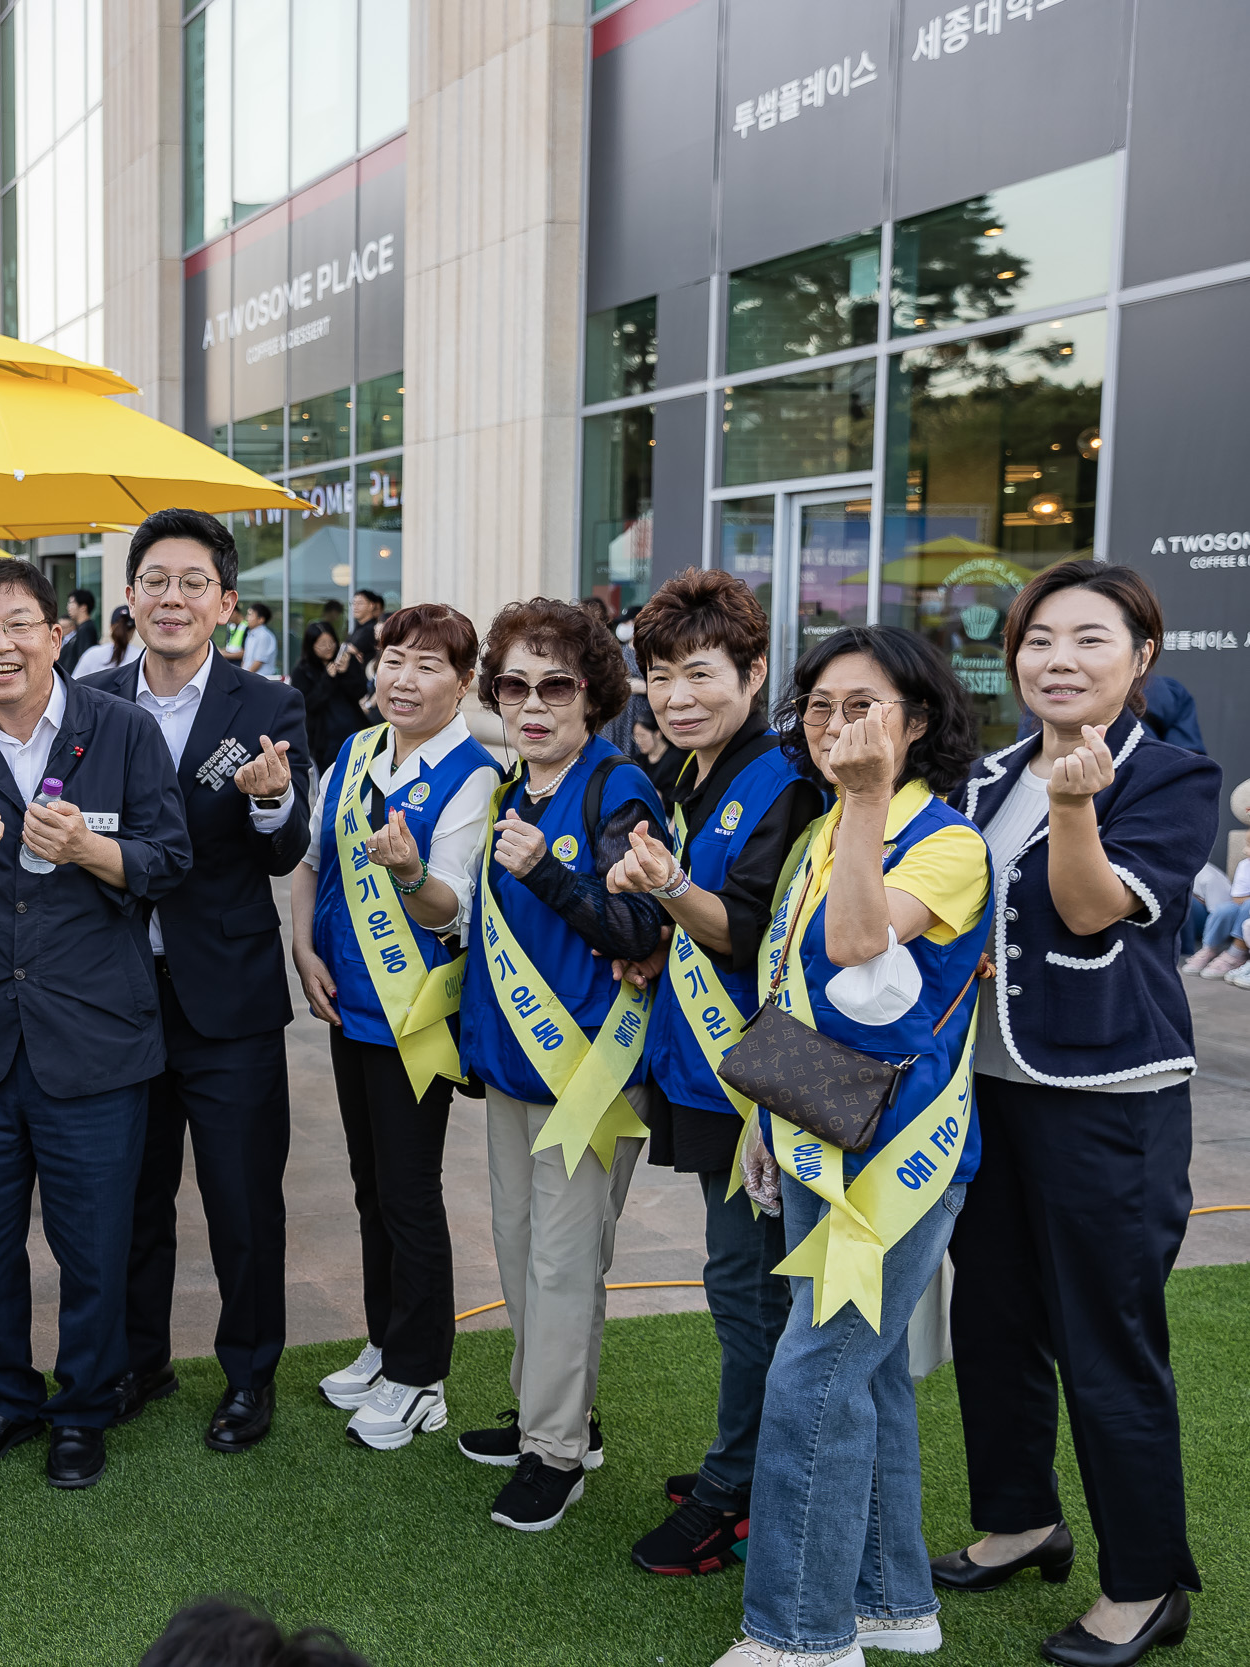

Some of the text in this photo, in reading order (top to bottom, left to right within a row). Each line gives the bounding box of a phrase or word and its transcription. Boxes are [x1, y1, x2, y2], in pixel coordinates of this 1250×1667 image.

[733, 50, 878, 139] 투썸플레이스
[202, 232, 395, 350] A TWOSOME PLACE
[287, 315, 332, 349] DESSERT
[1151, 536, 1167, 555] A
[1190, 553, 1247, 569] COFFEE &
[1162, 630, 1239, 651] 썸플레이스
[950, 652, 1006, 669] Premium
[198, 744, 229, 775] 당협위원장
[200, 742, 252, 791] 김병민
[87, 816, 114, 825] 김경호
